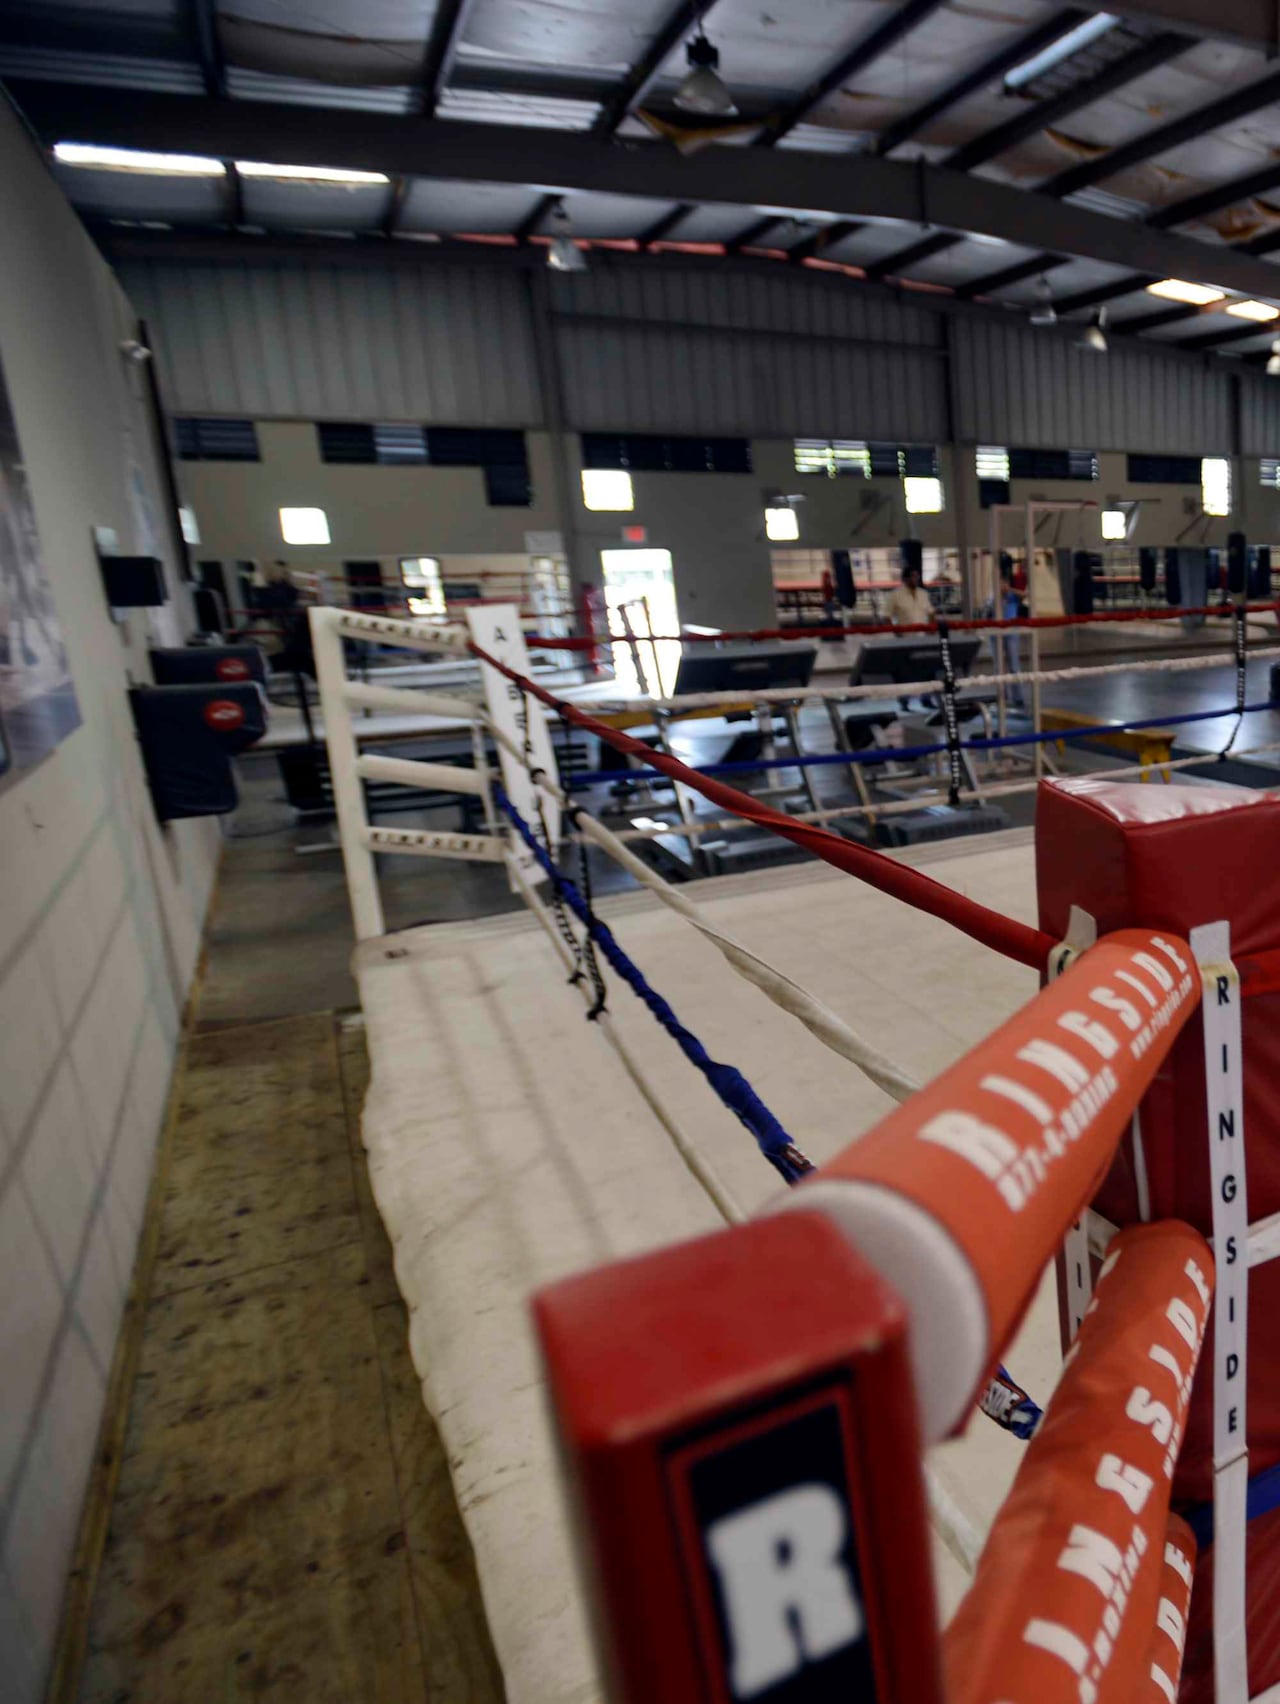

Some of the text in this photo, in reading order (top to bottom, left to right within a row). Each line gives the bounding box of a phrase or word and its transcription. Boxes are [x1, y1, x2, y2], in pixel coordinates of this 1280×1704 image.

[917, 936, 1187, 1181] RINGSIDE
[1216, 976, 1243, 1433] RINGSIDE
[706, 1483, 864, 1699] R
